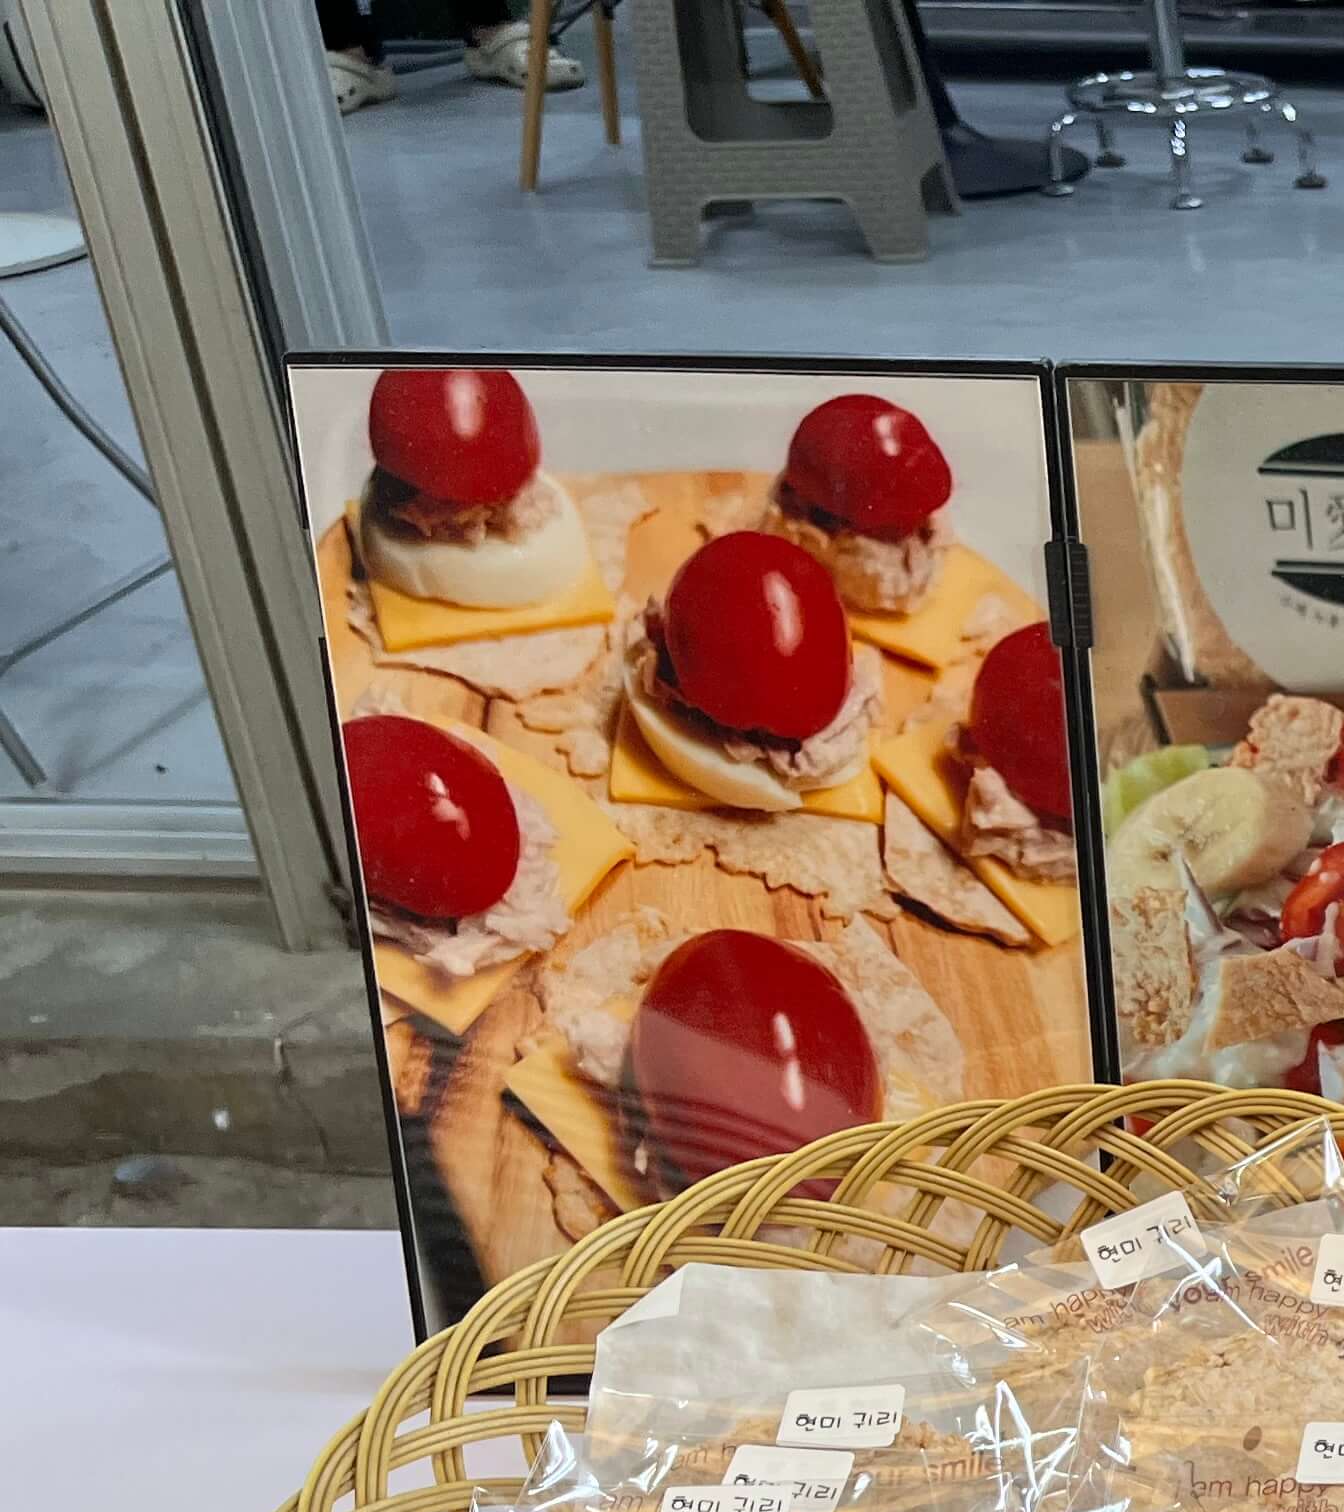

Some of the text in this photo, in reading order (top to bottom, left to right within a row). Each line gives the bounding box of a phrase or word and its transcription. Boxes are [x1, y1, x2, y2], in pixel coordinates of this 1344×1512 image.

[1097, 1236, 1142, 1263] 현미
[795, 1411, 898, 1433] 현미 귀리
[791, 1480, 838, 1503] 귀리
